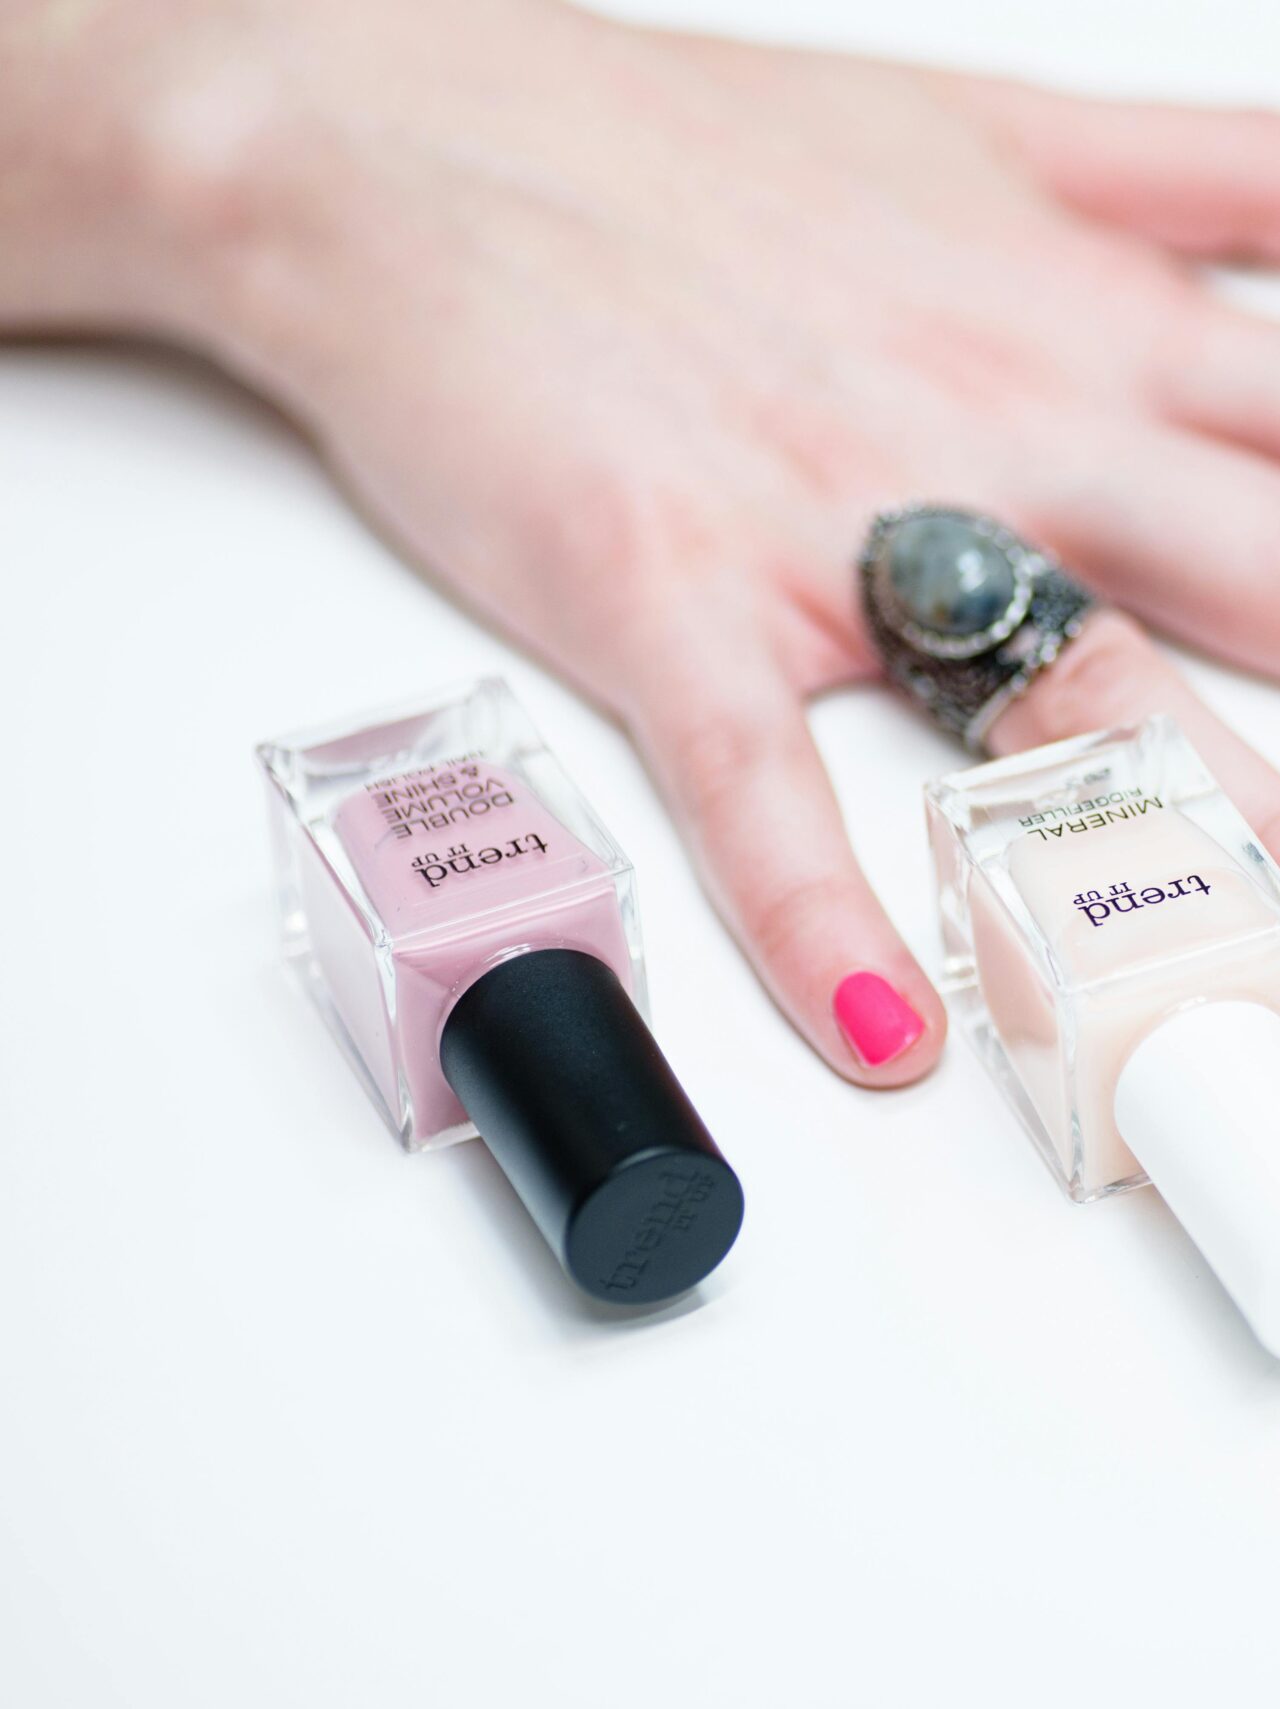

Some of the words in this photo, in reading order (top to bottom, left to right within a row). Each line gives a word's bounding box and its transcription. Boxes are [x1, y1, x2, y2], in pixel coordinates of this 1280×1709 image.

[372, 773, 457, 809] SHINE
[381, 777, 504, 824] VOLUME
[1018, 787, 1142, 827] RIDGEFILLER
[390, 791, 515, 839] DOUBLE
[1027, 796, 1164, 841] MINERAL
[411, 852, 441, 868] UP
[414, 833, 548, 888] trend
[447, 843, 471, 857] IT
[1072, 890, 1104, 905] UP
[1077, 874, 1212, 927] trend
[1108, 882, 1133, 896] IT
